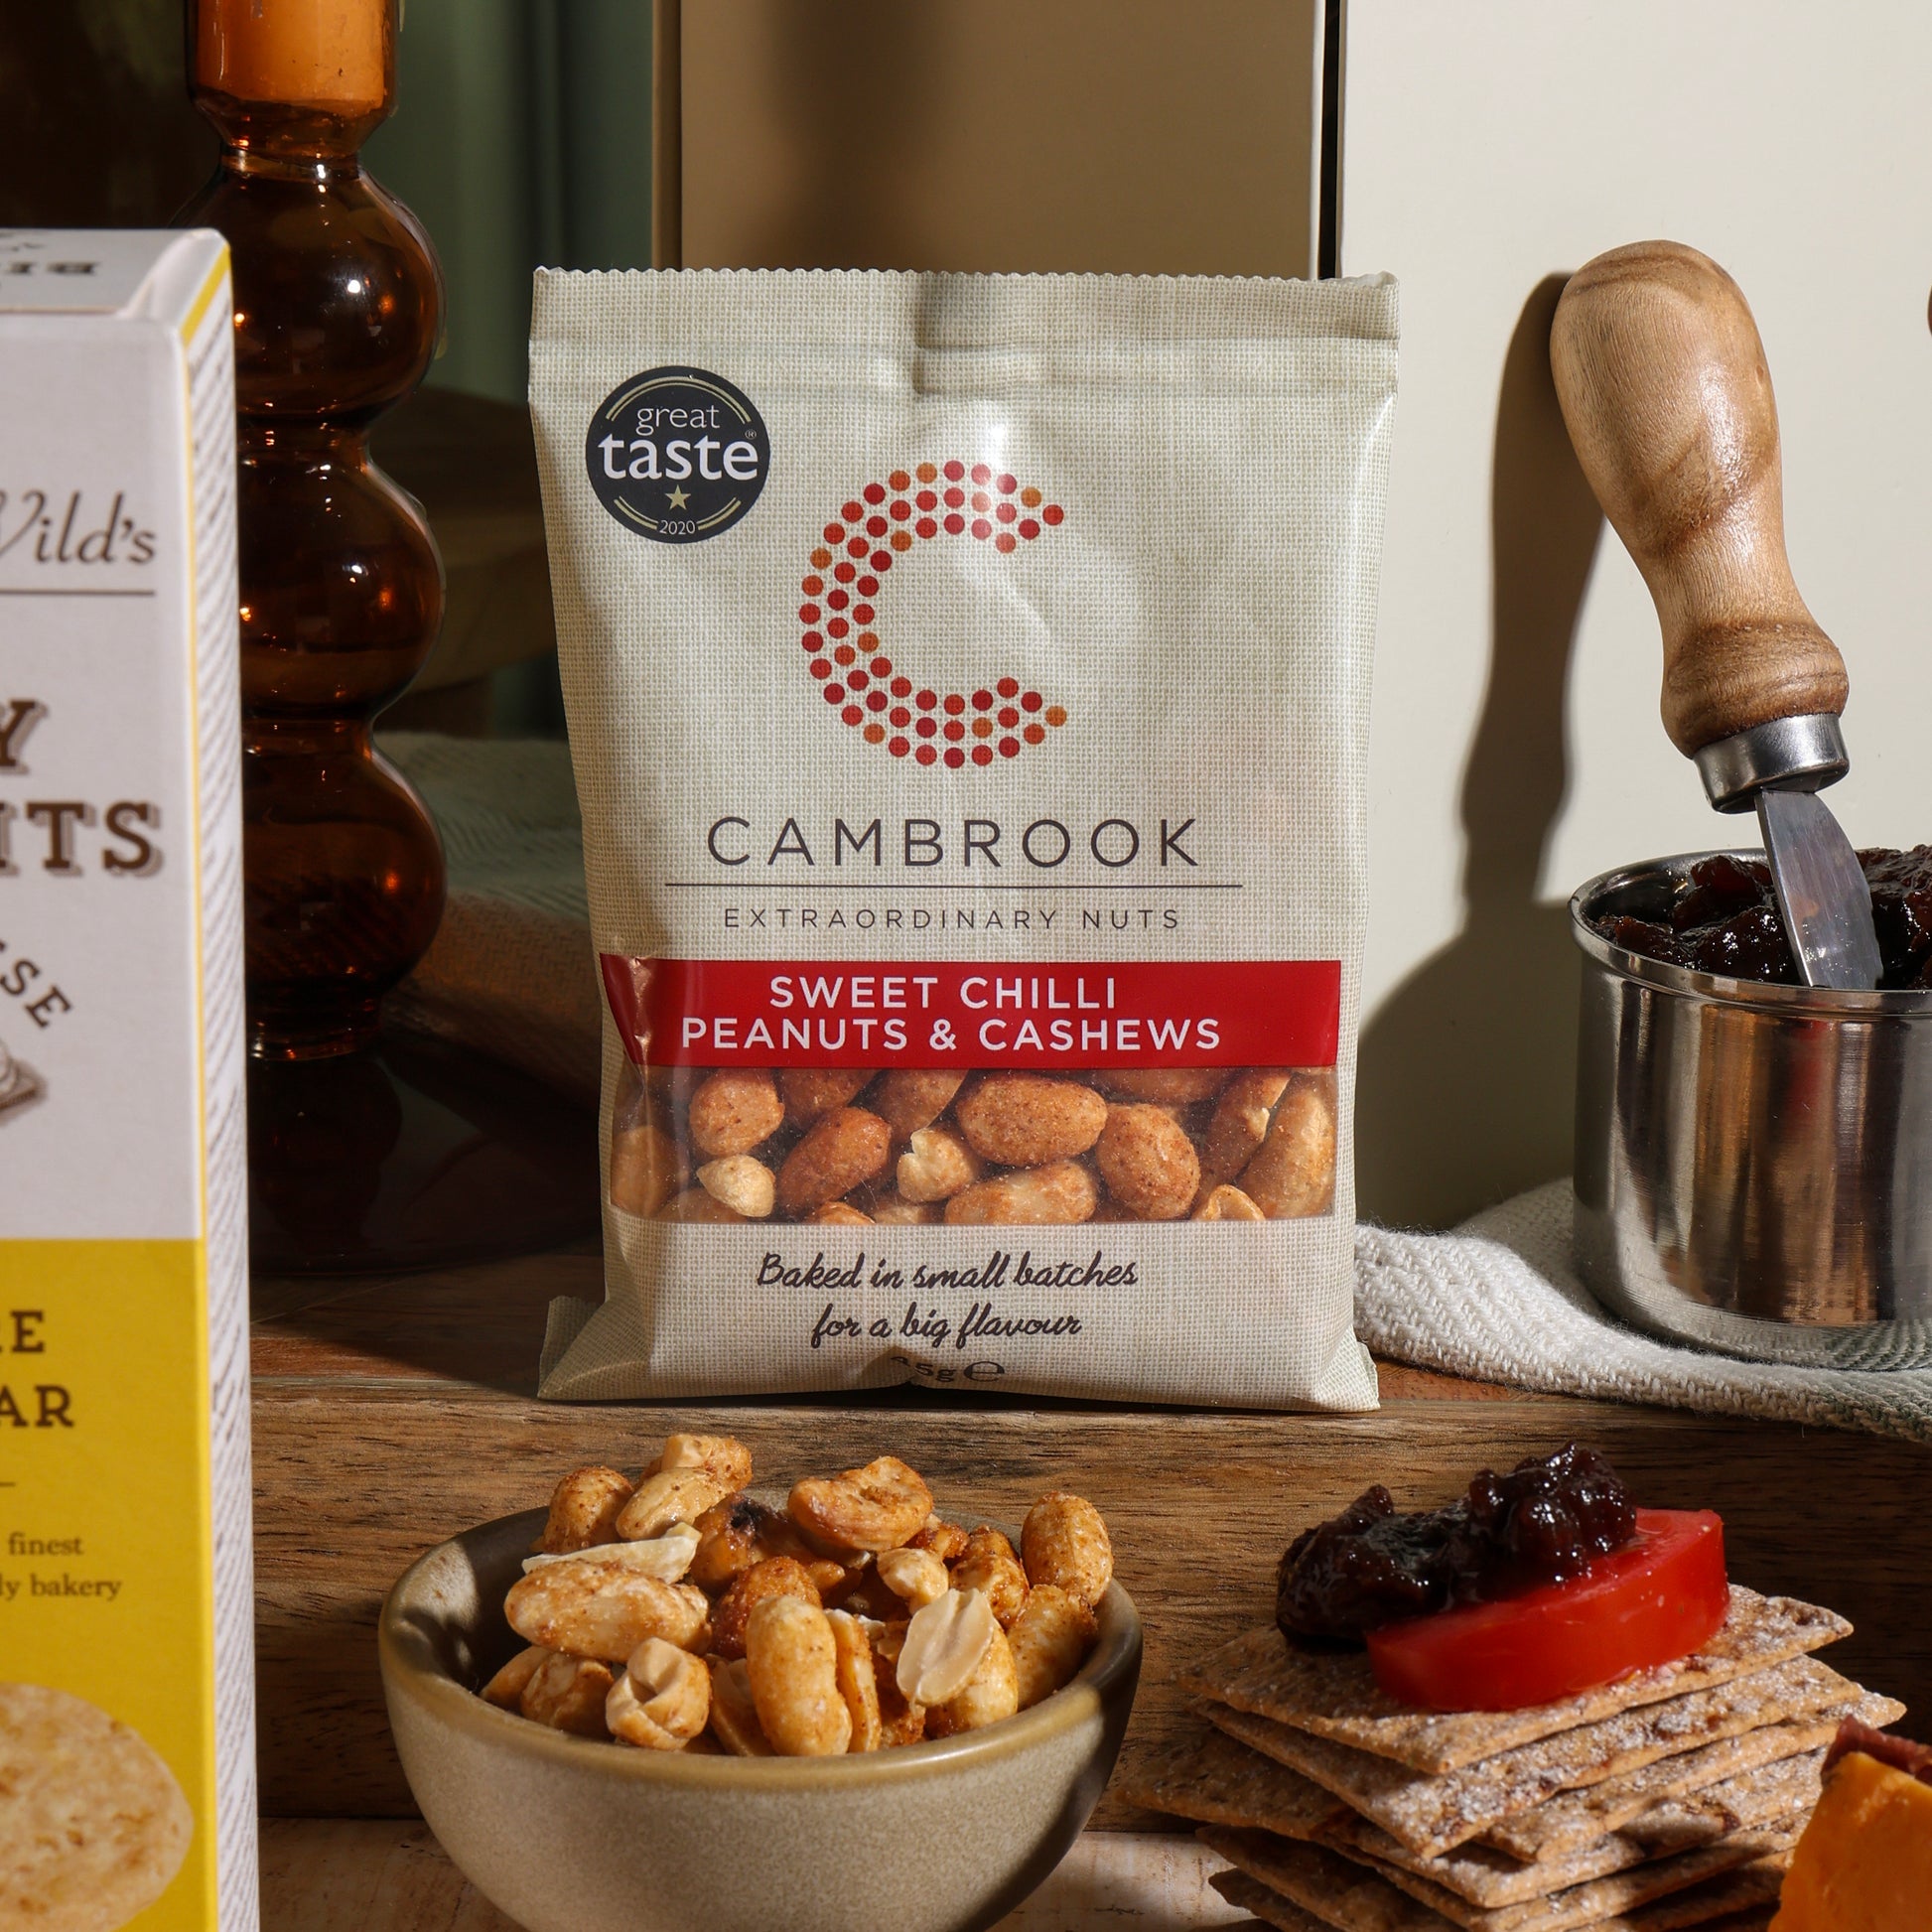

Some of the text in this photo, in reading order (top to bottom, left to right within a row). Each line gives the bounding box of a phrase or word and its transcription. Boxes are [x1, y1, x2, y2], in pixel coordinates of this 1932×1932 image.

[635, 404, 721, 436] great
[598, 433, 759, 481] taste
[659, 519, 696, 535] 2020
[0, 801, 163, 877] TS
[707, 816, 1199, 868] CAMBROOK
[724, 907, 1180, 930] EXTRAORDINARY NUTS
[0, 939, 72, 1029] SE
[769, 976, 1116, 1010] SWEET CHILLI
[681, 1017, 1221, 1051] PEANUTS & CASHEWS
[757, 1250, 1139, 1290] Baked in small batches
[0, 1310, 45, 1354] E
[810, 1302, 1083, 1350] for a big flavour
[8, 1531, 85, 1557] finest
[30, 1573, 123, 1602] bakery
